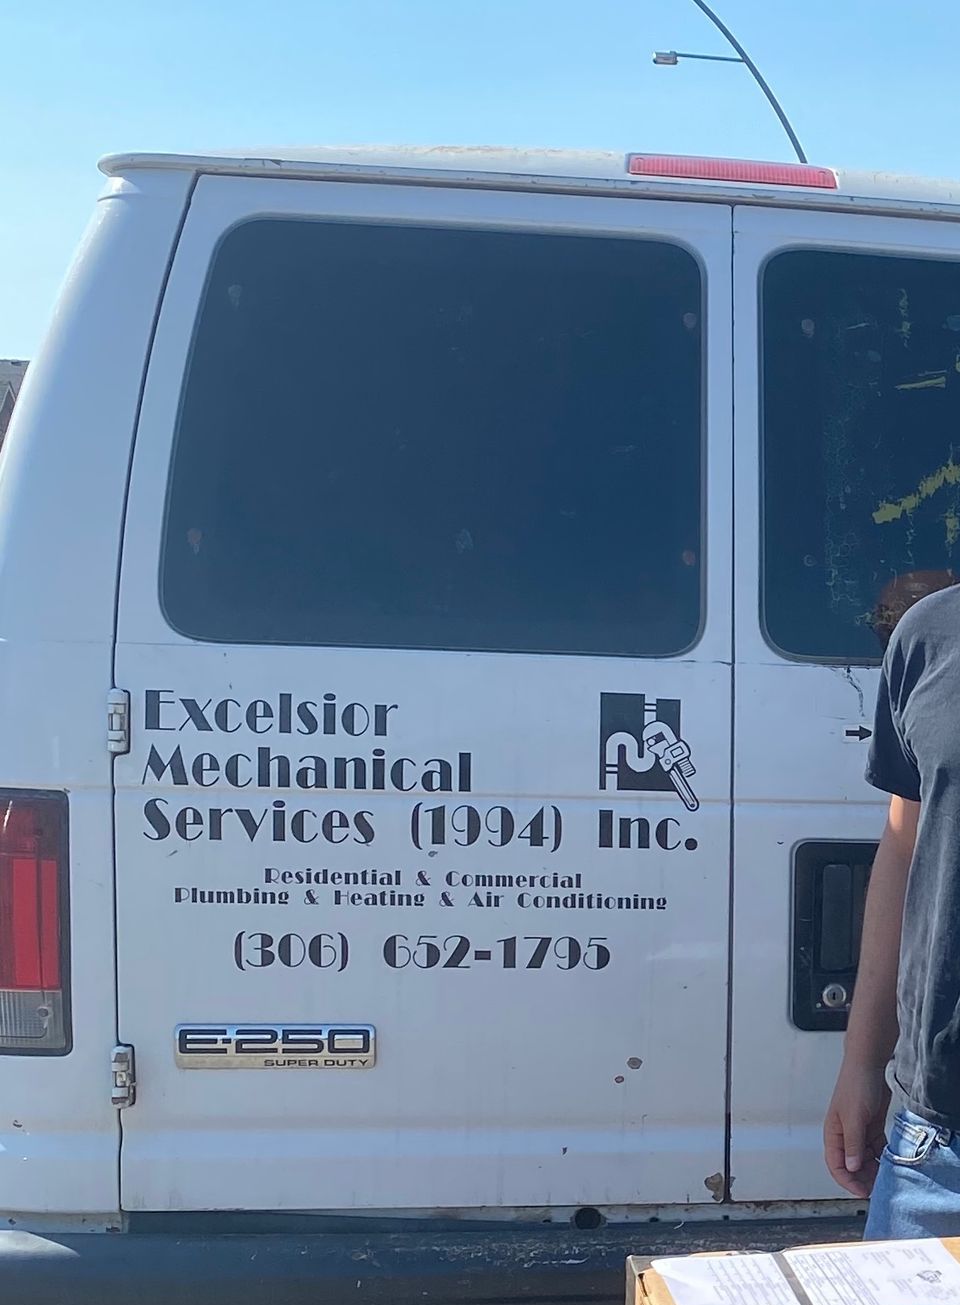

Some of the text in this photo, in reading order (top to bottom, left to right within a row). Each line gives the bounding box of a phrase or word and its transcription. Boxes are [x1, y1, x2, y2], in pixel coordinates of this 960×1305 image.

[145, 689, 399, 737] Excelsior
[141, 744, 472, 793] Mechanical
[142, 798, 699, 852] Services (1994) Inc.
[264, 868, 583, 889] Residential & Commercial
[174, 887, 668, 910] Plumbing & Heating & Air Conditioning
[234, 931, 611, 972] (306) 652-1795
[178, 1029, 371, 1054] E-250
[264, 1058, 370, 1067] SUPER DUTY
